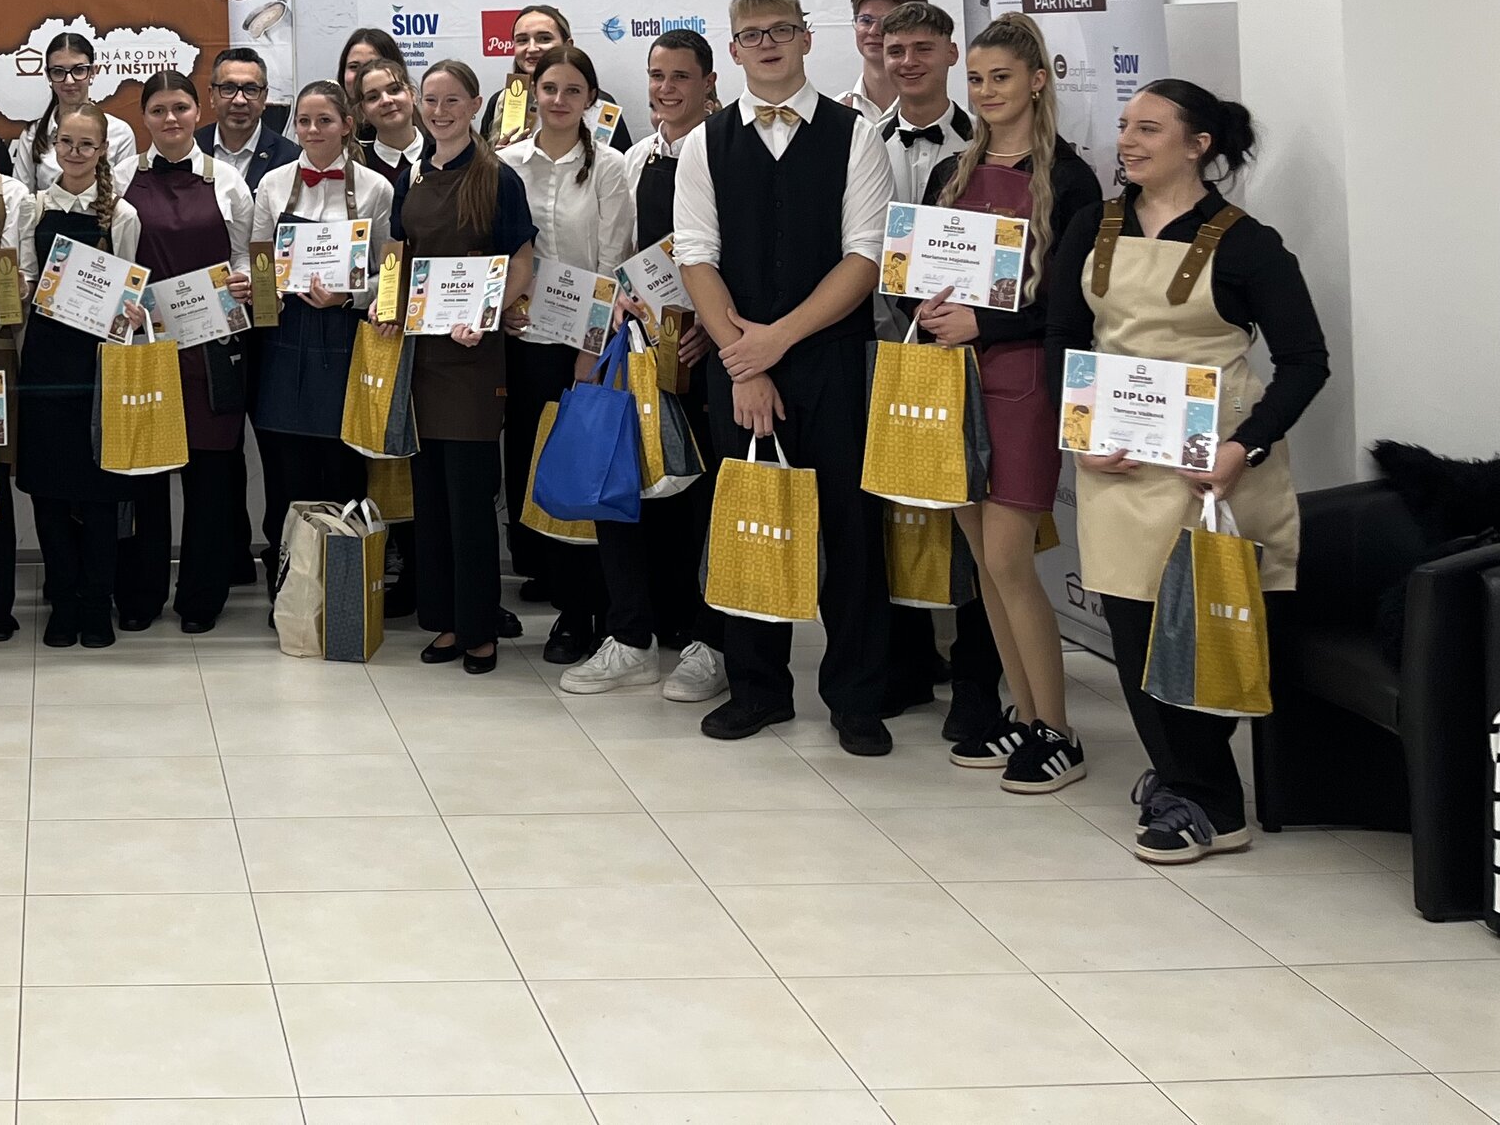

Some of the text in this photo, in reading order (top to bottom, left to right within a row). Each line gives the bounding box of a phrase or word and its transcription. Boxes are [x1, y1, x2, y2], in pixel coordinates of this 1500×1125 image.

[392, 5, 439, 35] ŠIOV
[116, 59, 179, 74] INŠTITÚT
[1113, 46, 1139, 74] ŠIOV
[306, 244, 339, 252] DIPLOM
[928, 239, 977, 252] DIPLOM
[77, 269, 111, 288] DIPLOM
[647, 272, 674, 291] DIPLOM
[170, 295, 206, 310] DIPLOM
[546, 286, 581, 303] DIPLOM
[1113, 390, 1167, 405] DIPLOM
